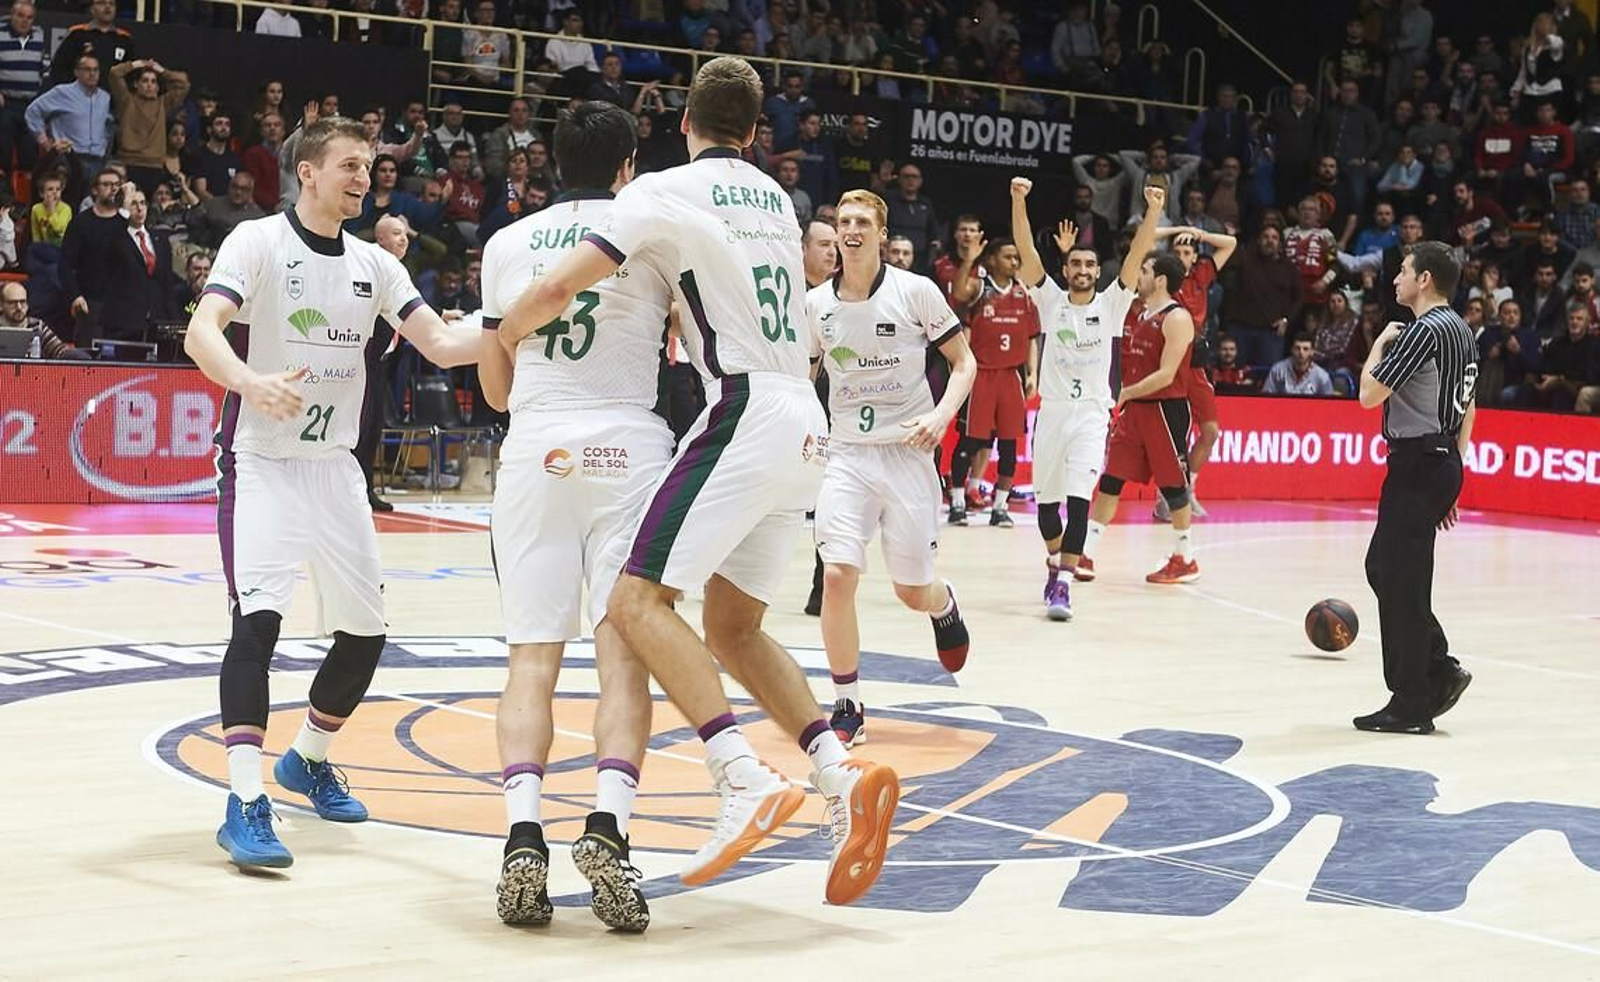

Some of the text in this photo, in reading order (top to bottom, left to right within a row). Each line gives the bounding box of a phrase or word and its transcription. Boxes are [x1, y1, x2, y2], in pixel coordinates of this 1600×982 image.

[911, 108, 1073, 154] MOTOR DYE
[911, 144, 926, 158] 26
[928, 146, 954, 160] años
[969, 149, 1039, 168] Fuenlabrada
[751, 264, 797, 343] 52
[1000, 334, 1010, 351] 3
[858, 354, 901, 368] Unicaja
[1070, 379, 1083, 399] 3
[299, 404, 335, 442] 21
[858, 405, 876, 433] 9
[582, 447, 628, 458] COSTA
[1330, 433, 1363, 465] TU
[583, 459, 628, 469] DEL SOL
